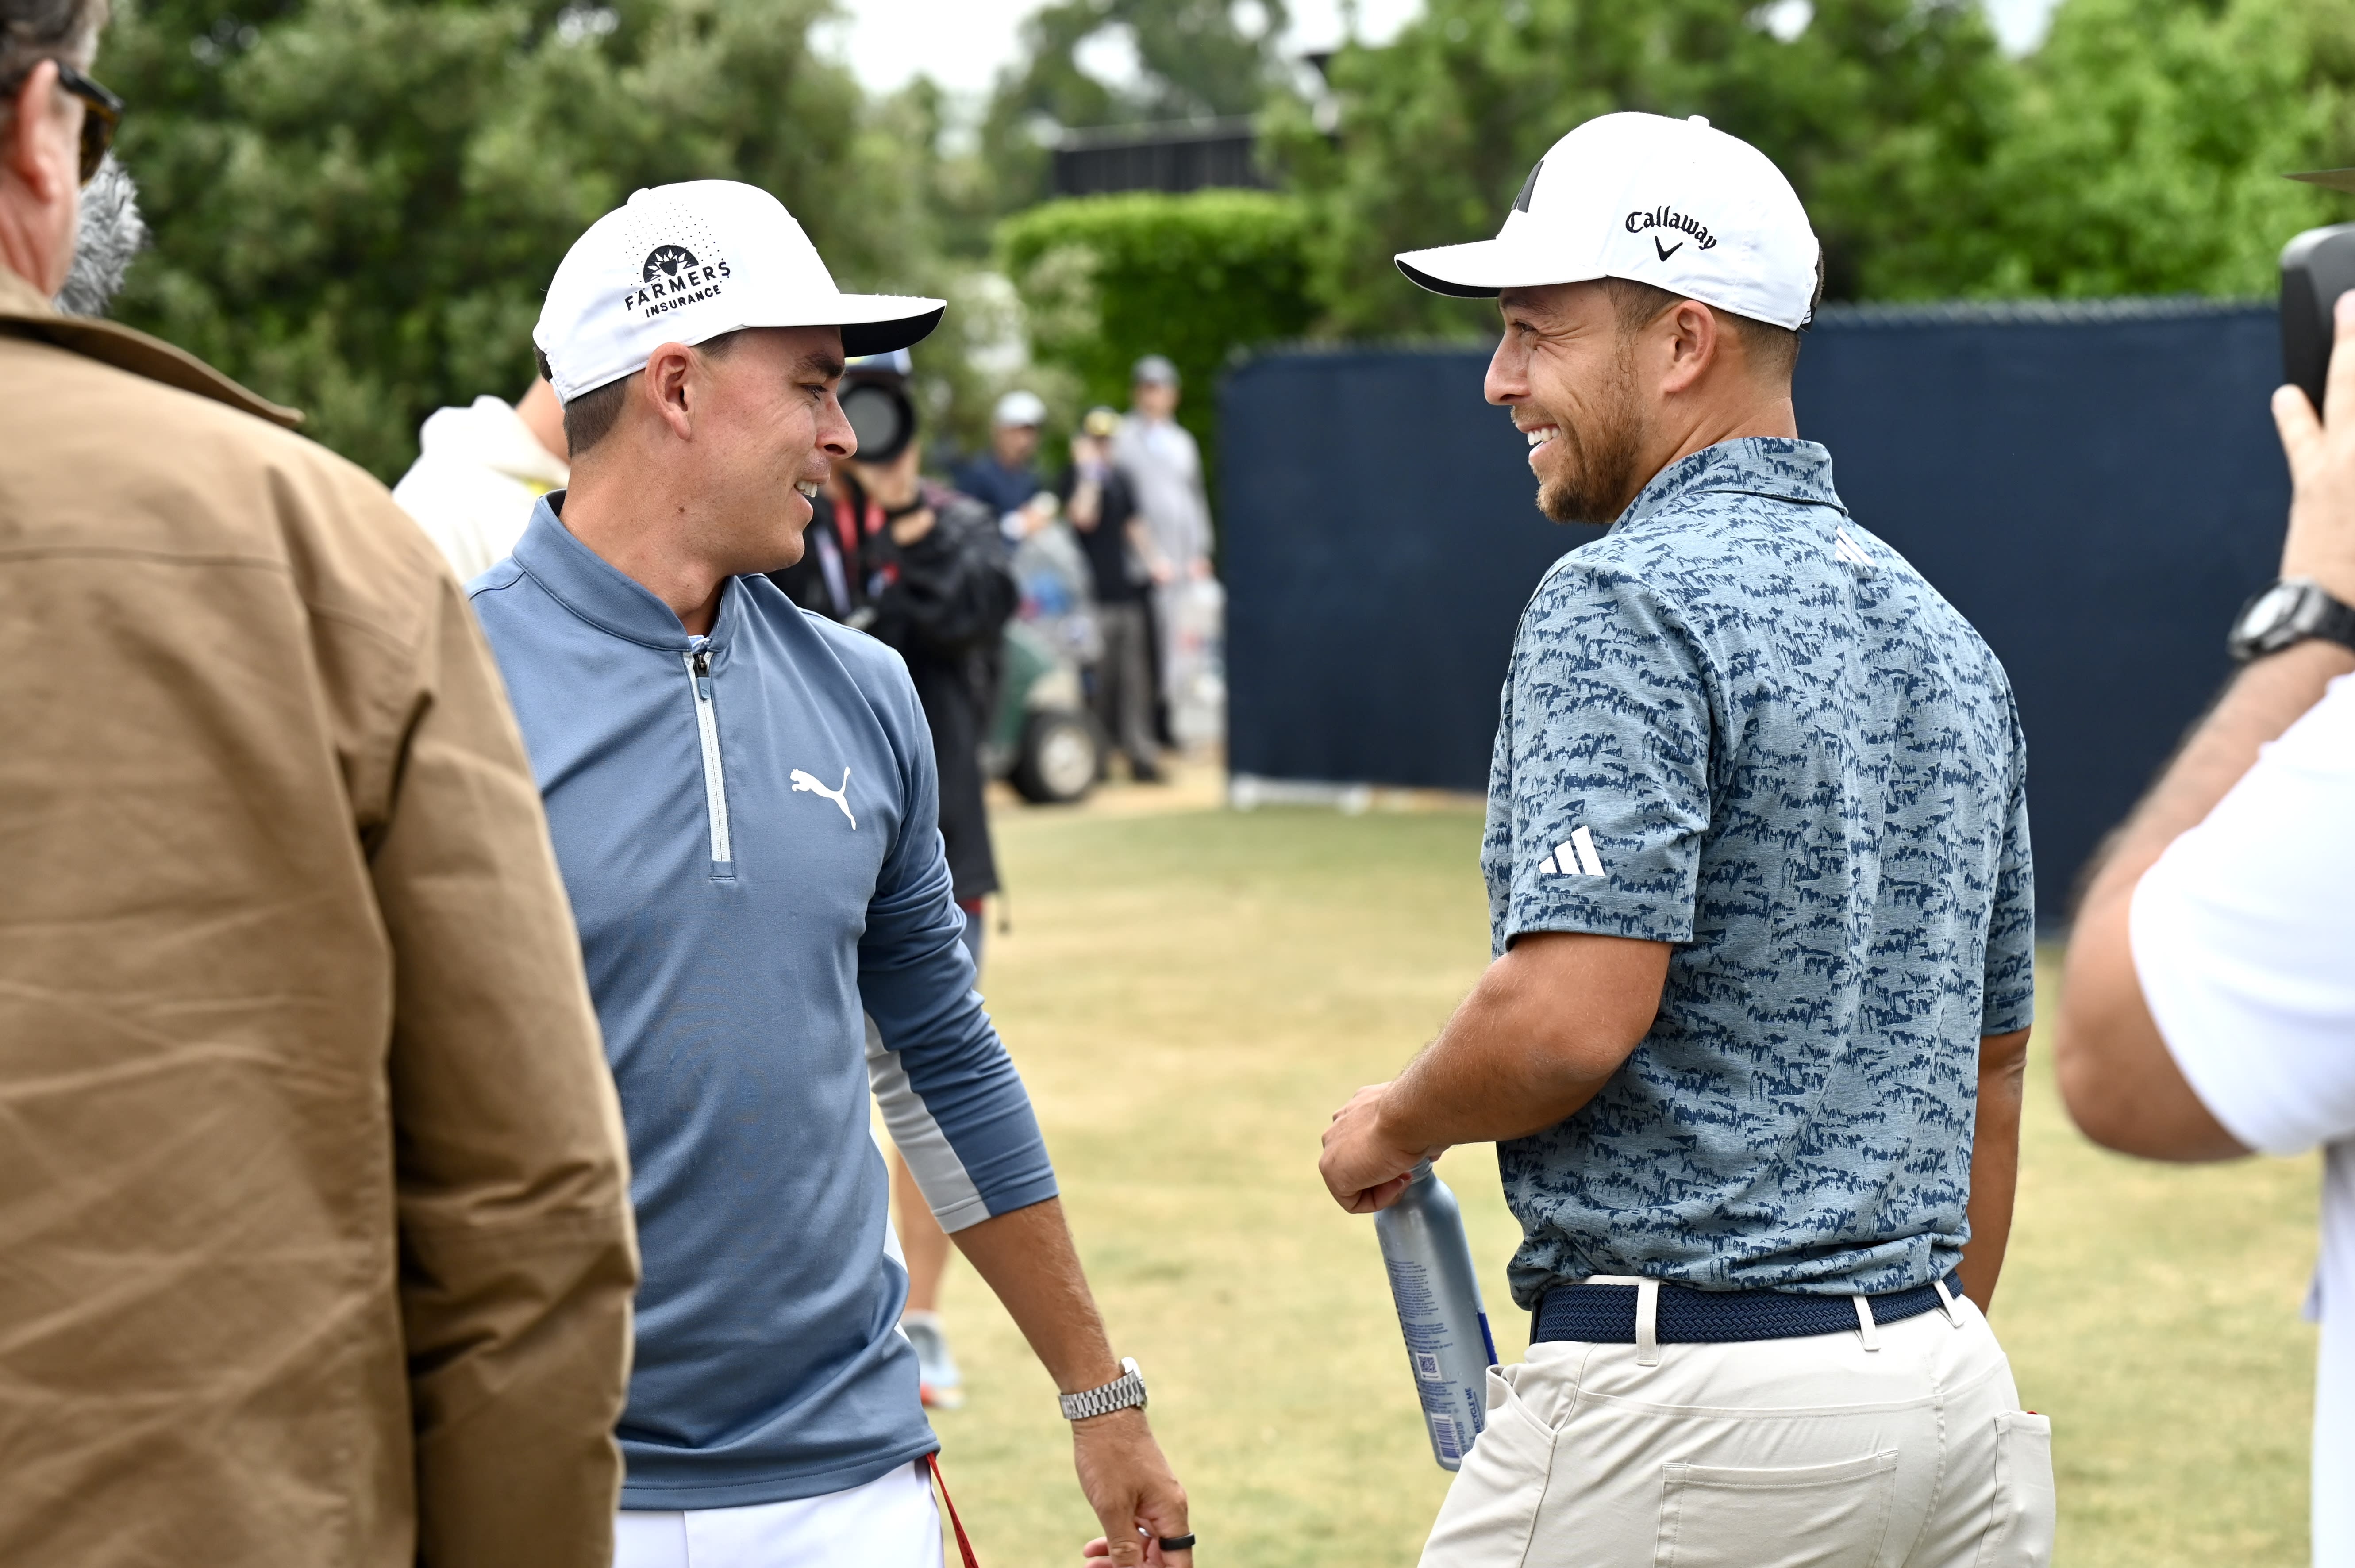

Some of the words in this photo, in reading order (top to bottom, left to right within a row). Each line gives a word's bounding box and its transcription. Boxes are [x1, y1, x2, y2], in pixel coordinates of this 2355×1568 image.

[1625, 205, 1717, 250] Callaway
[624, 261, 731, 311] FARMERS
[645, 285, 721, 318] INSURANCE
[1464, 1387, 1473, 1400] ME
[1468, 1401, 1481, 1434] RECYCLE
